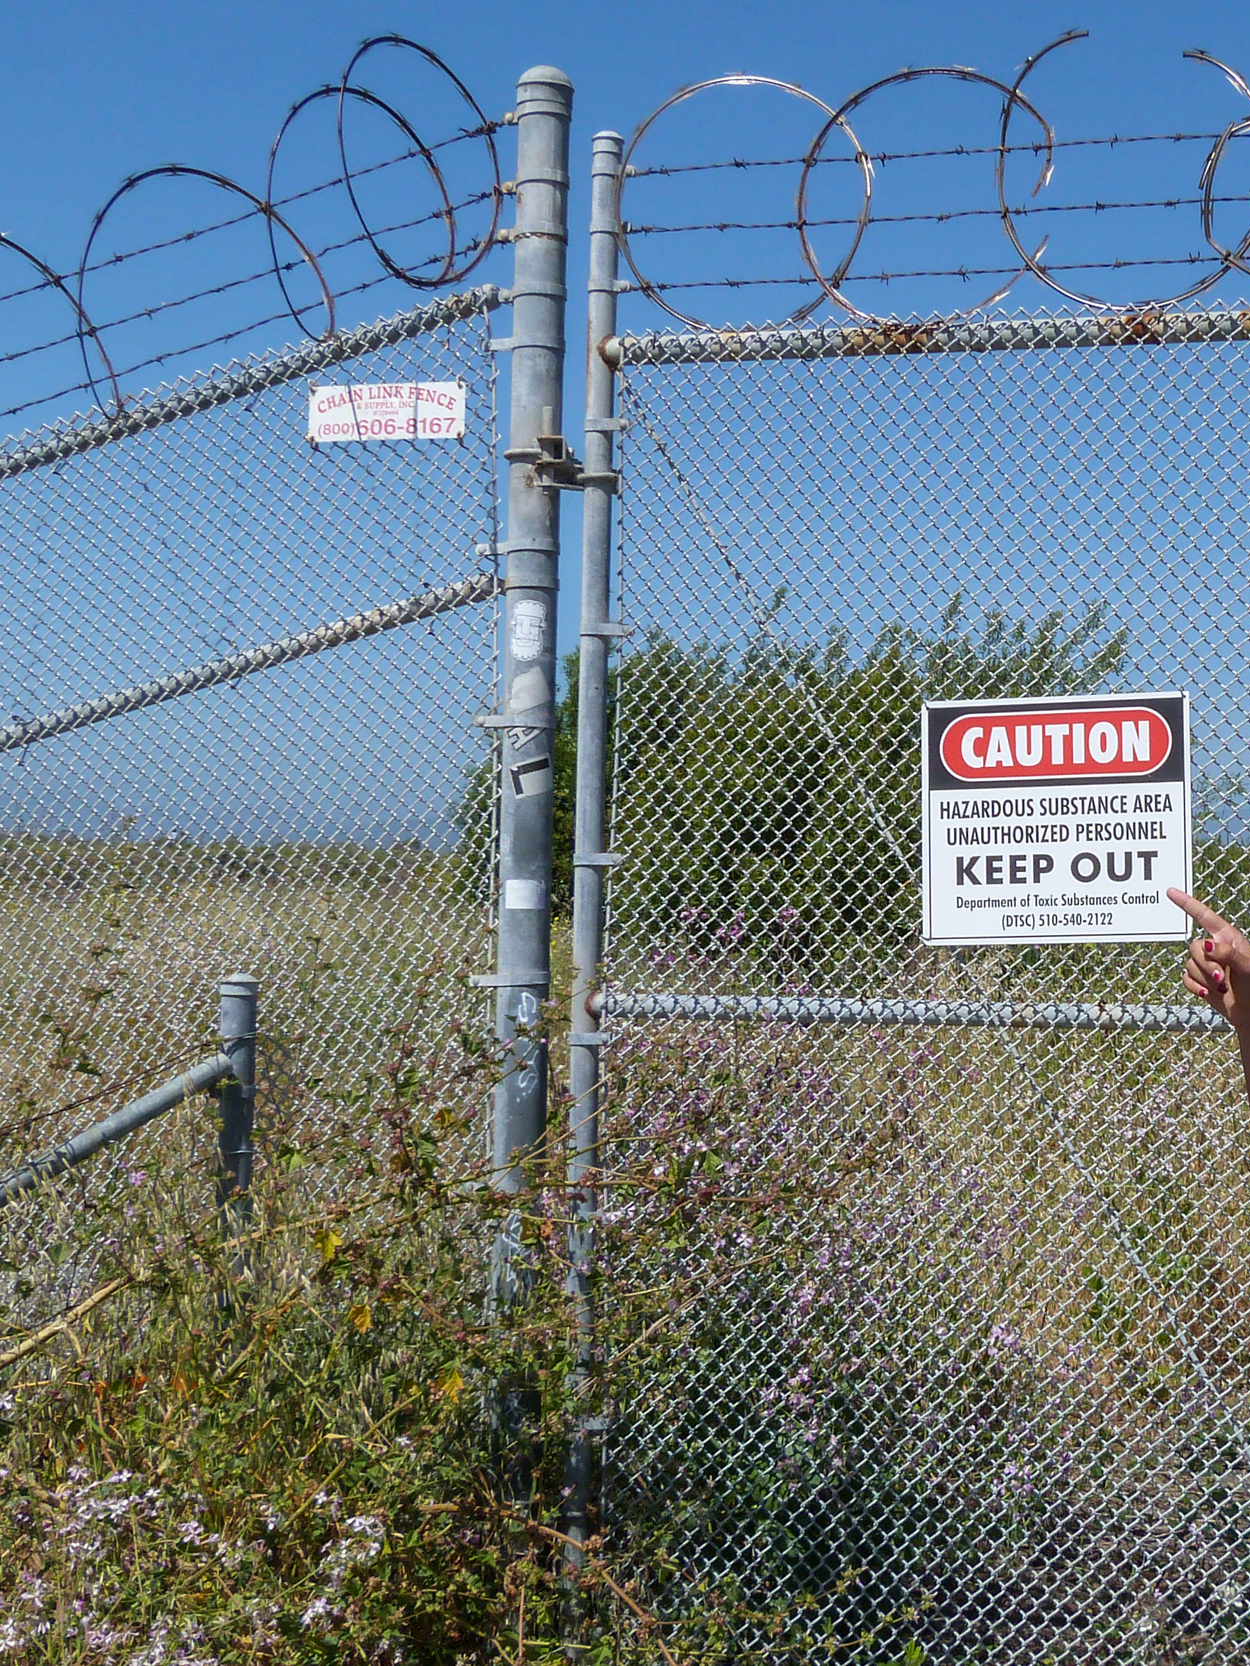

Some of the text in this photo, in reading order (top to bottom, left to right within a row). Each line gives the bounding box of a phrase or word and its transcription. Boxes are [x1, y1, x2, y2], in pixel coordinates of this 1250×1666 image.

[317, 386, 457, 413] CHAIN LINK FENCE
[356, 402, 362, 410] &
[961, 720, 1150, 769] CAUTION
[940, 793, 1173, 820] HAZARDOUS SUBSTANCE AREA
[946, 821, 1167, 846] UNAUTHORIZED PERSONNEL
[956, 850, 1159, 886] KEEP OUT
[956, 891, 1159, 911] Department of Toxic Substances Control
[1001, 913, 1113, 931] (DTSC) 510-540-2122
